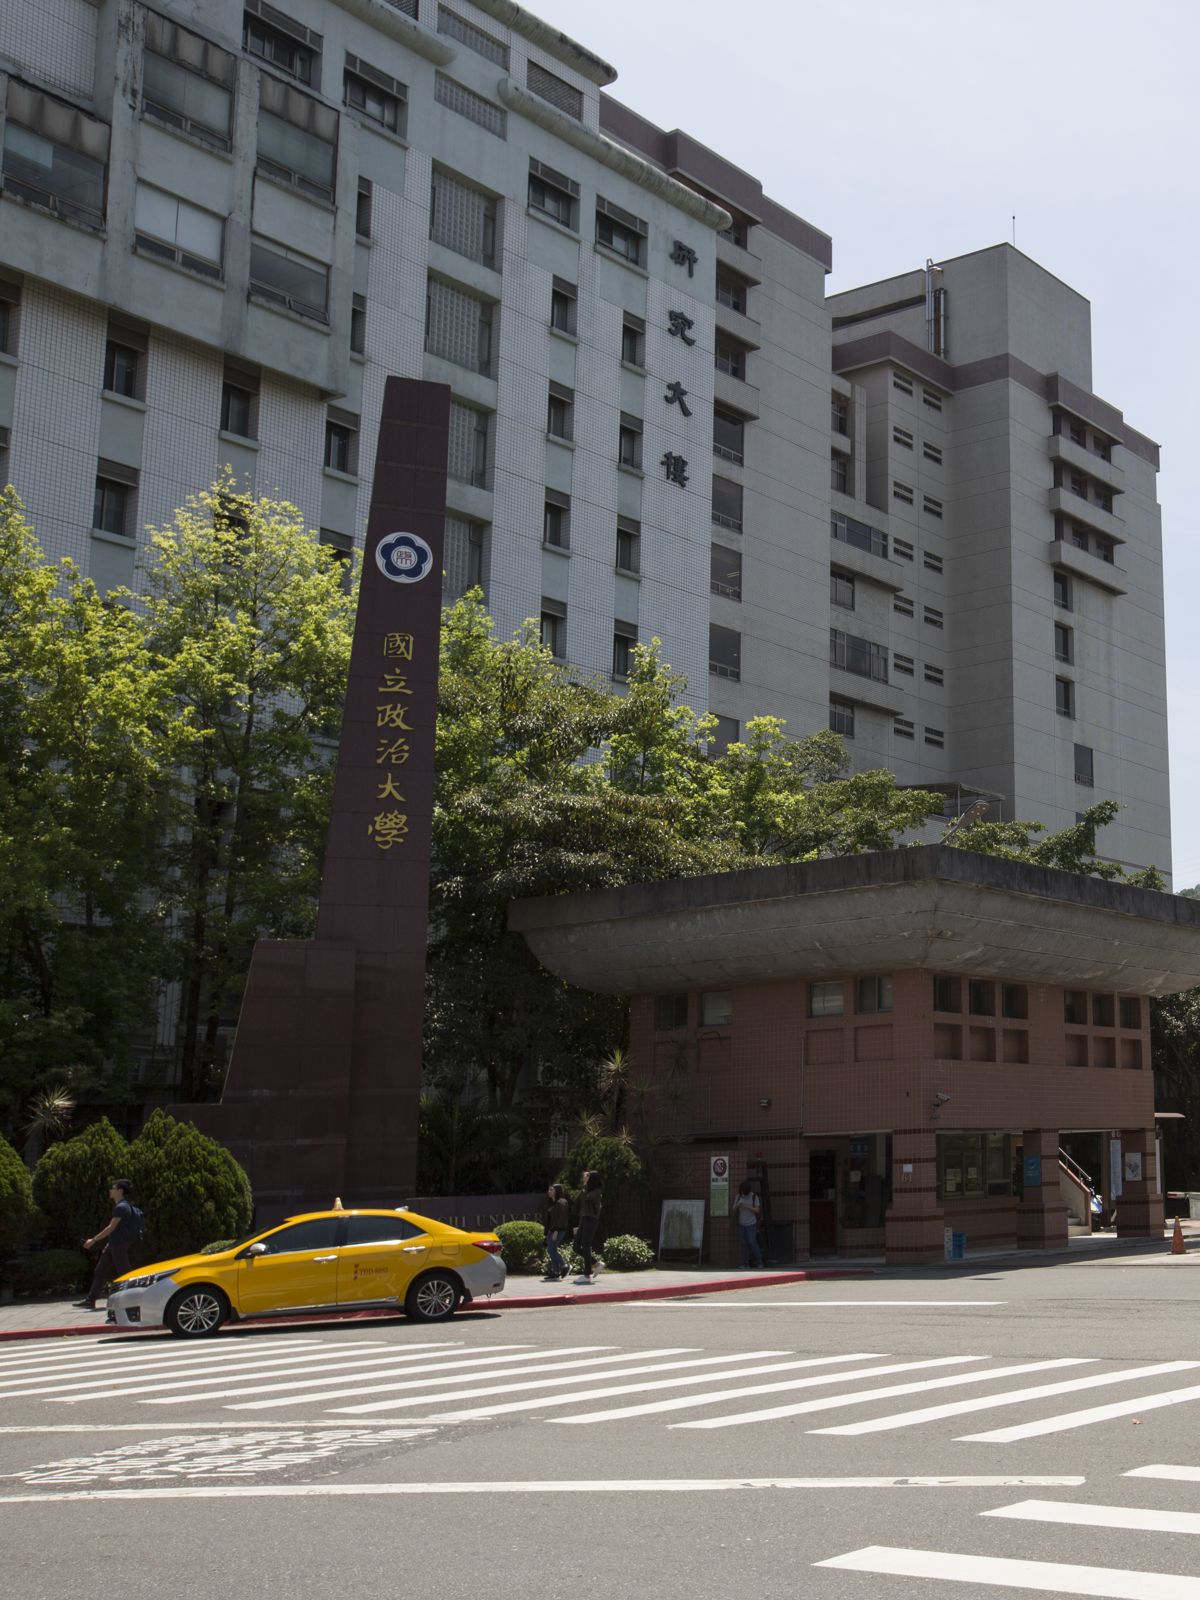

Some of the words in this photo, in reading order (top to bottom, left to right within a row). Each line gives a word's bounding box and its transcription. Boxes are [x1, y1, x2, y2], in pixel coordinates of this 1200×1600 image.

[660, 240, 698, 488] 研究大樓
[368, 632, 414, 850] 國立政治大學
